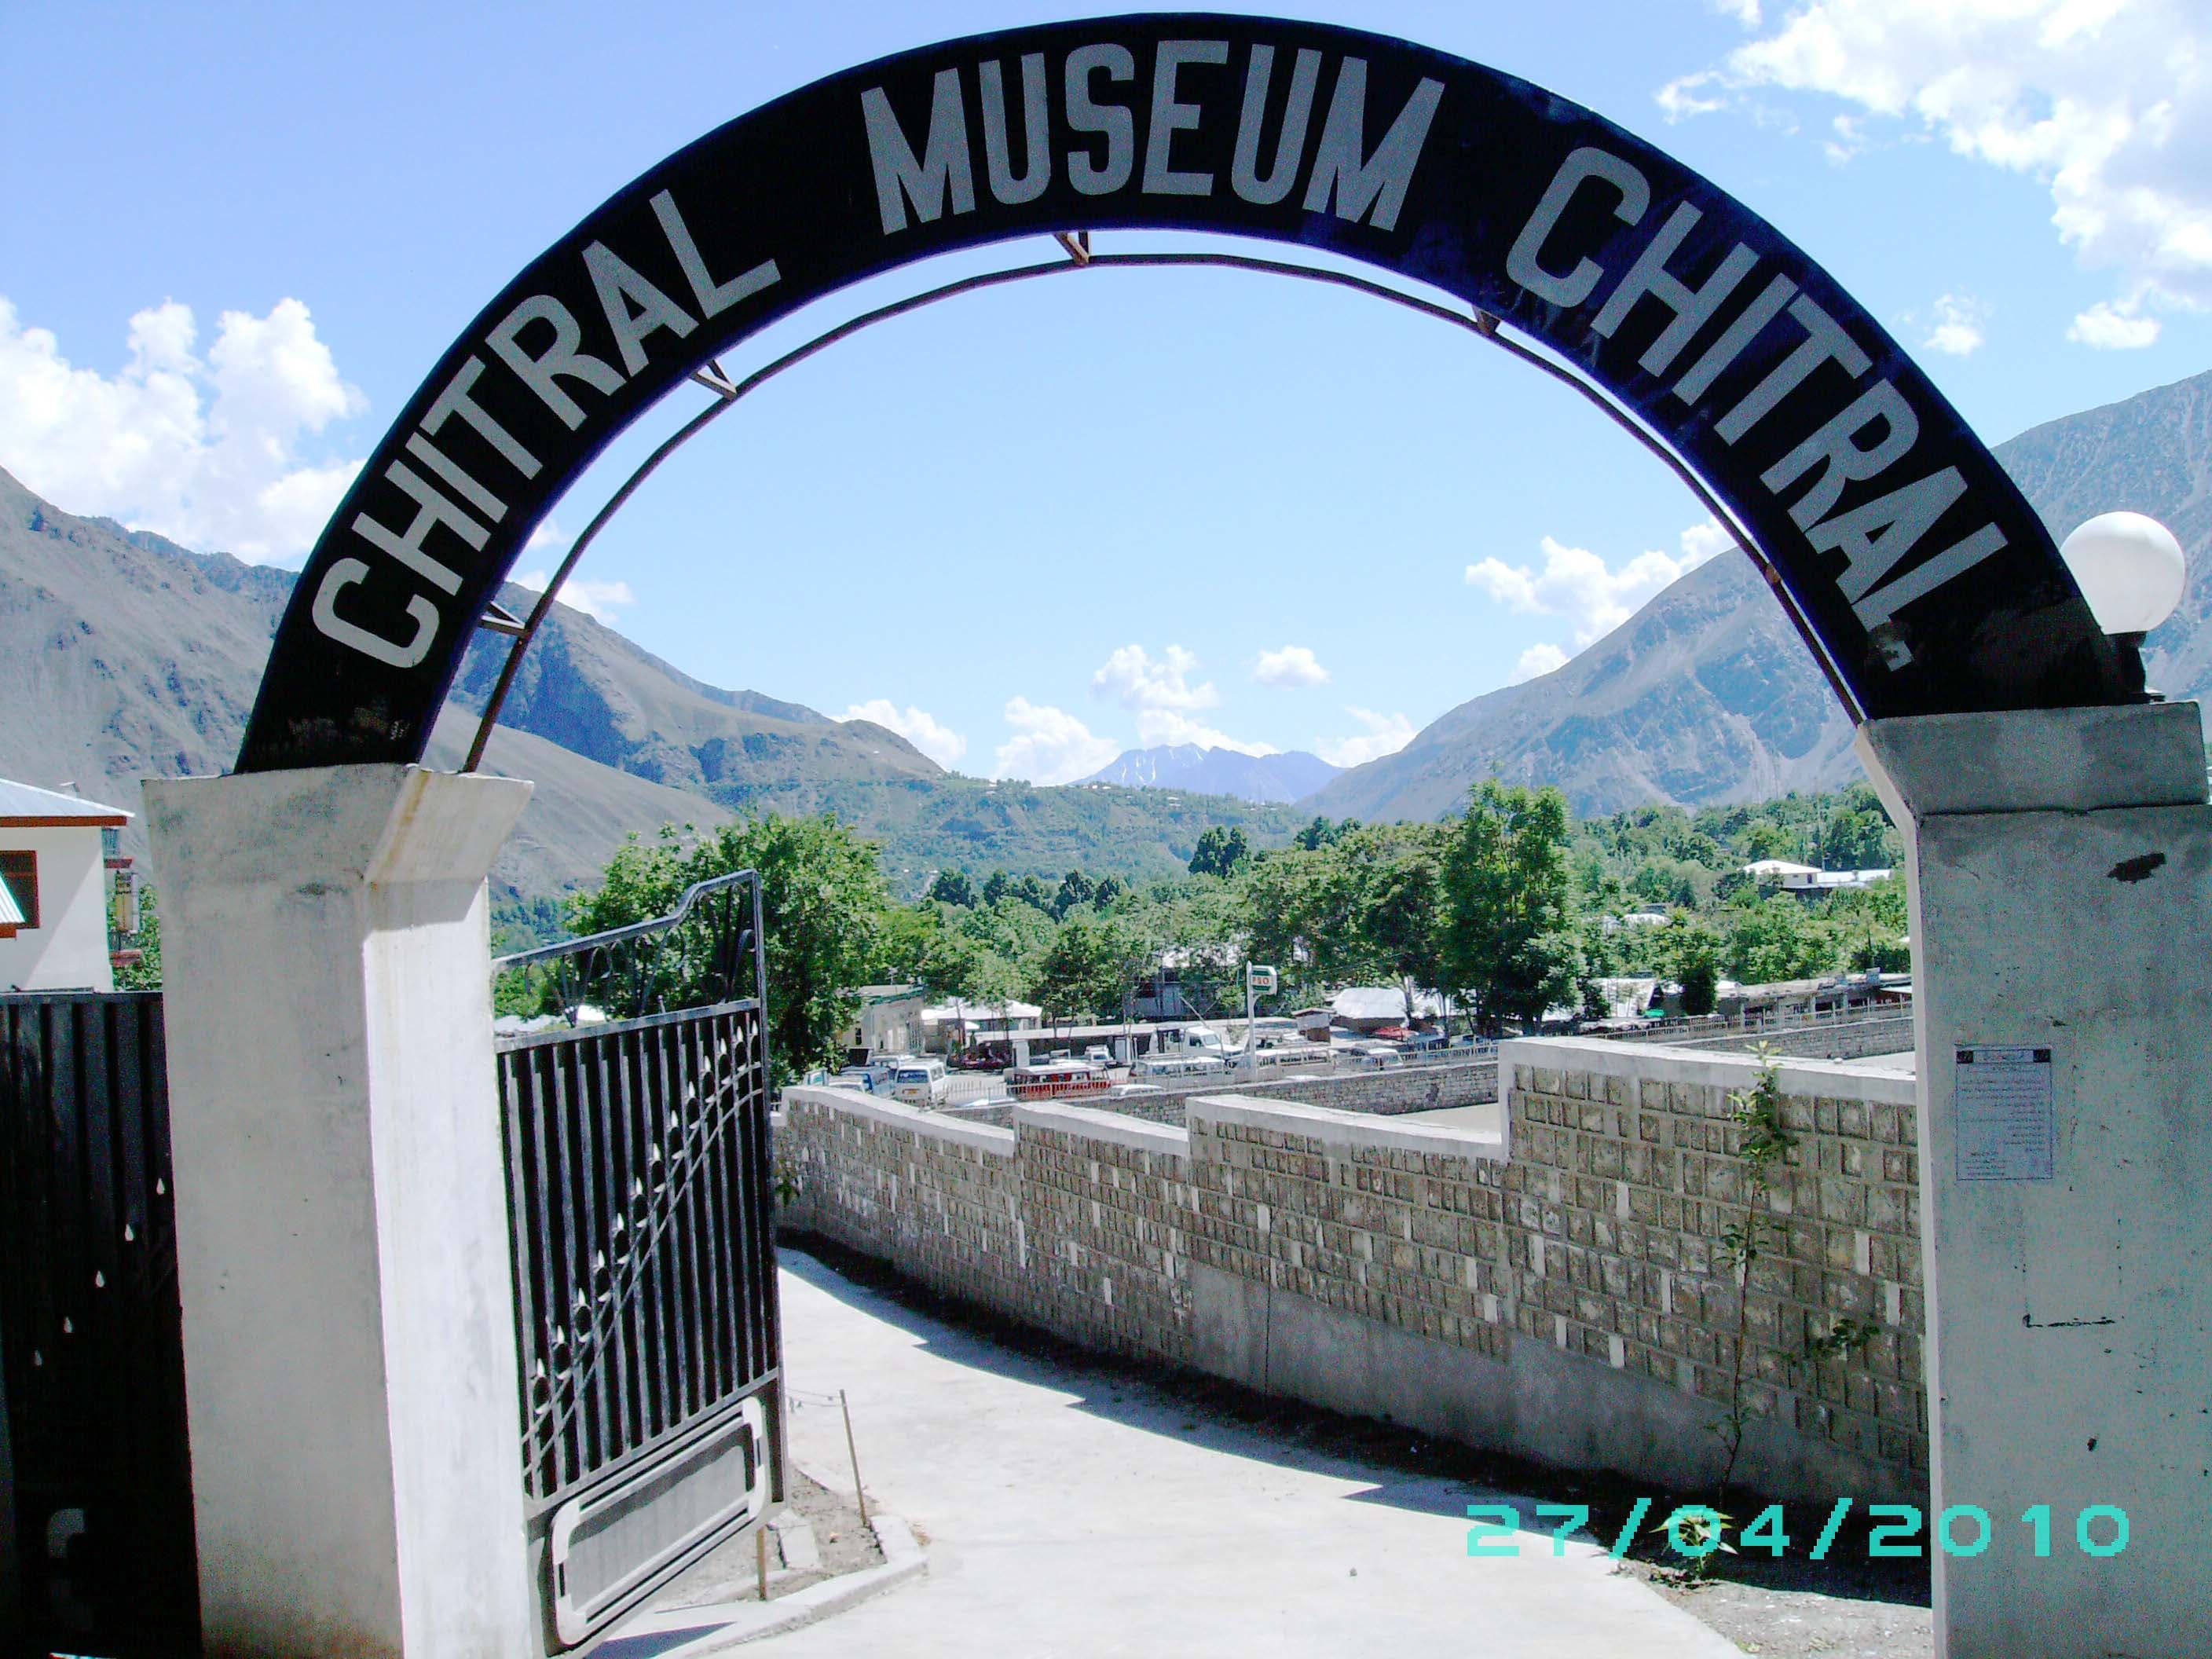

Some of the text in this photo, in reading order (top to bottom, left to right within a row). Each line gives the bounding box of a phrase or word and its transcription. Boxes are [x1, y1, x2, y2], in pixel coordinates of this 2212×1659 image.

[312, 39, 2009, 672] CHITRAL MUSEUM CHITRAL
